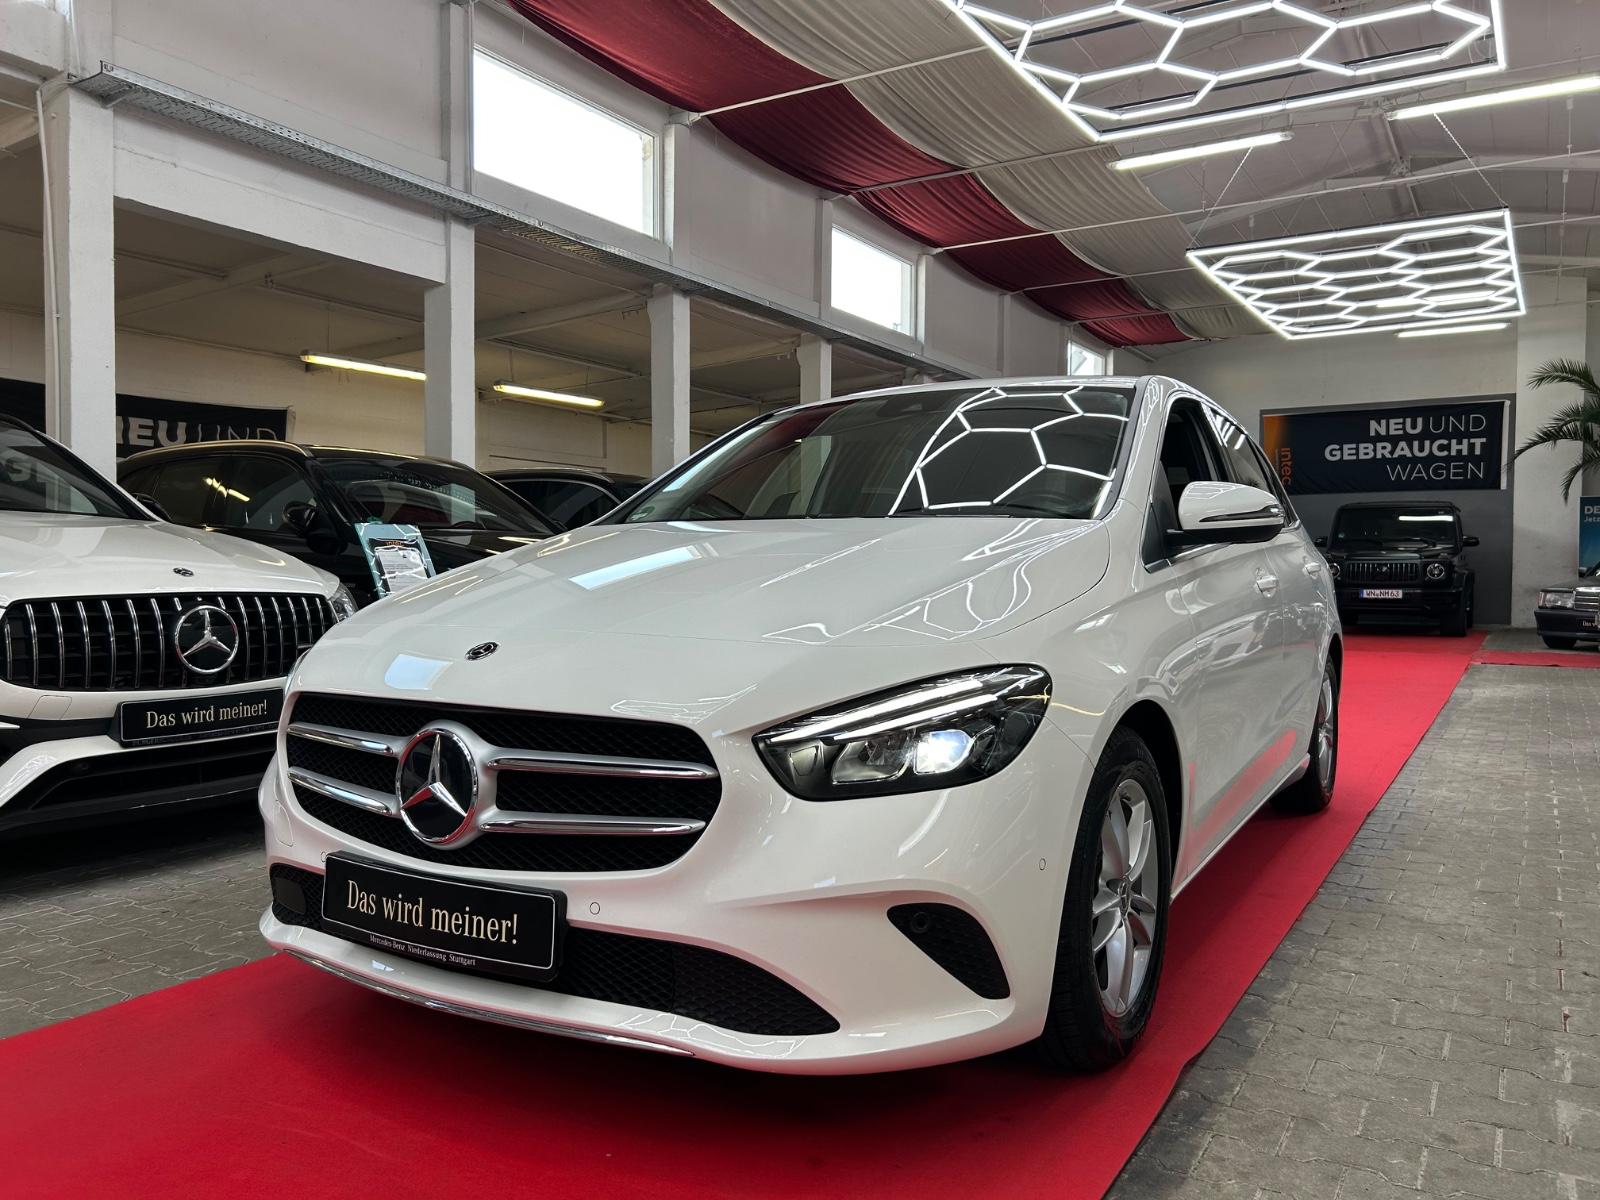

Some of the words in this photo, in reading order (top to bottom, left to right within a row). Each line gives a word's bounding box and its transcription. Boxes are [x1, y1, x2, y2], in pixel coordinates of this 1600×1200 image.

[1369, 417, 1423, 437] NEU
[1429, 414, 1486, 433] UND
[1324, 438, 1487, 461] GEBRAUCHT
[1386, 462, 1484, 481] WAGEN
[146, 711, 176, 729] Das
[181, 705, 215, 724] wird
[219, 699, 267, 721] meiner!
[347, 879, 376, 916] Das
[382, 893, 424, 927] wird
[430, 906, 518, 945] meiner!
[407, 945, 447, 961] Niederlassung
[449, 953, 476, 966] Stuttgart
